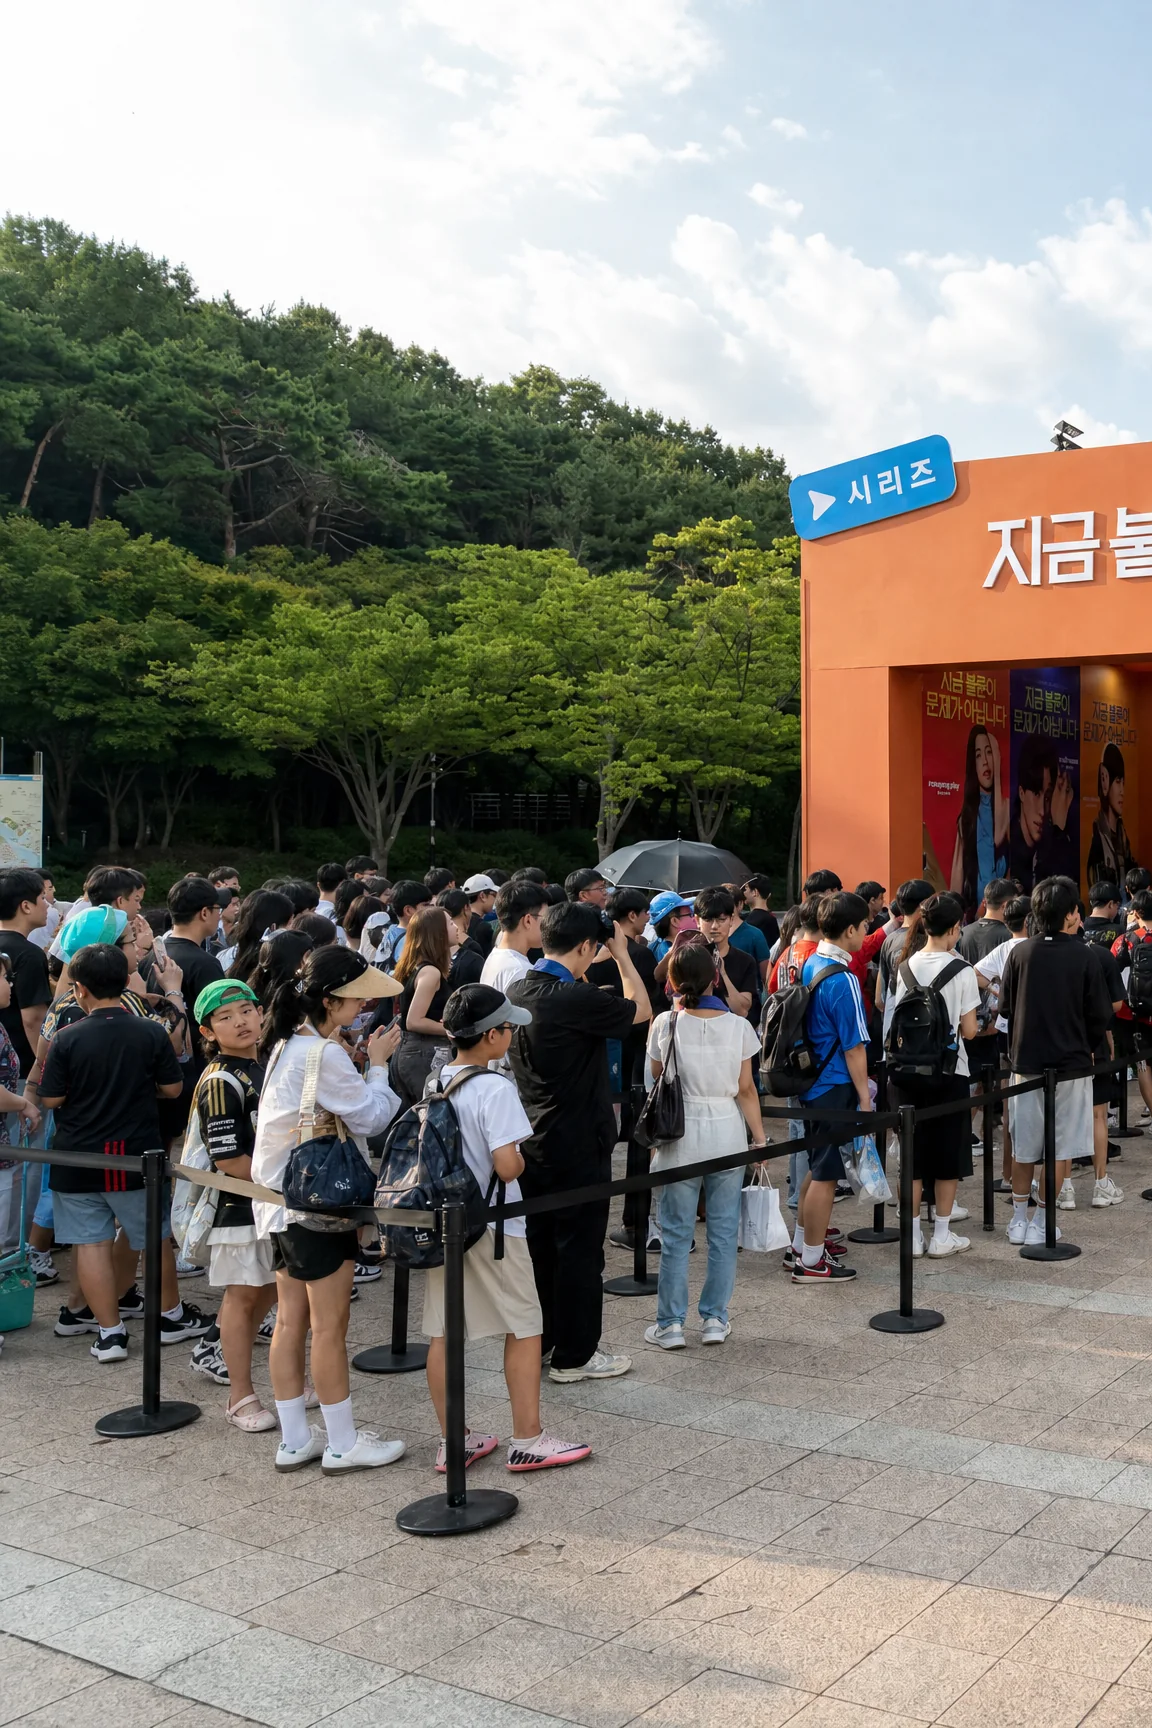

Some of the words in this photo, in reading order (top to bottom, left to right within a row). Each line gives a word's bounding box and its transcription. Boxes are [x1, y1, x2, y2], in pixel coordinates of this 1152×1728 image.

[847, 457, 937, 506] 시리즈
[983, 510, 1101, 589] 지금
[926, 691, 963, 721] 문제가
[964, 698, 1008, 729] 아닙니다
[1025, 686, 1044, 710] 지금
[1092, 700, 1109, 723] 지금
[1013, 709, 1042, 735] 문제가
[1042, 714, 1079, 741] 아닙니다
